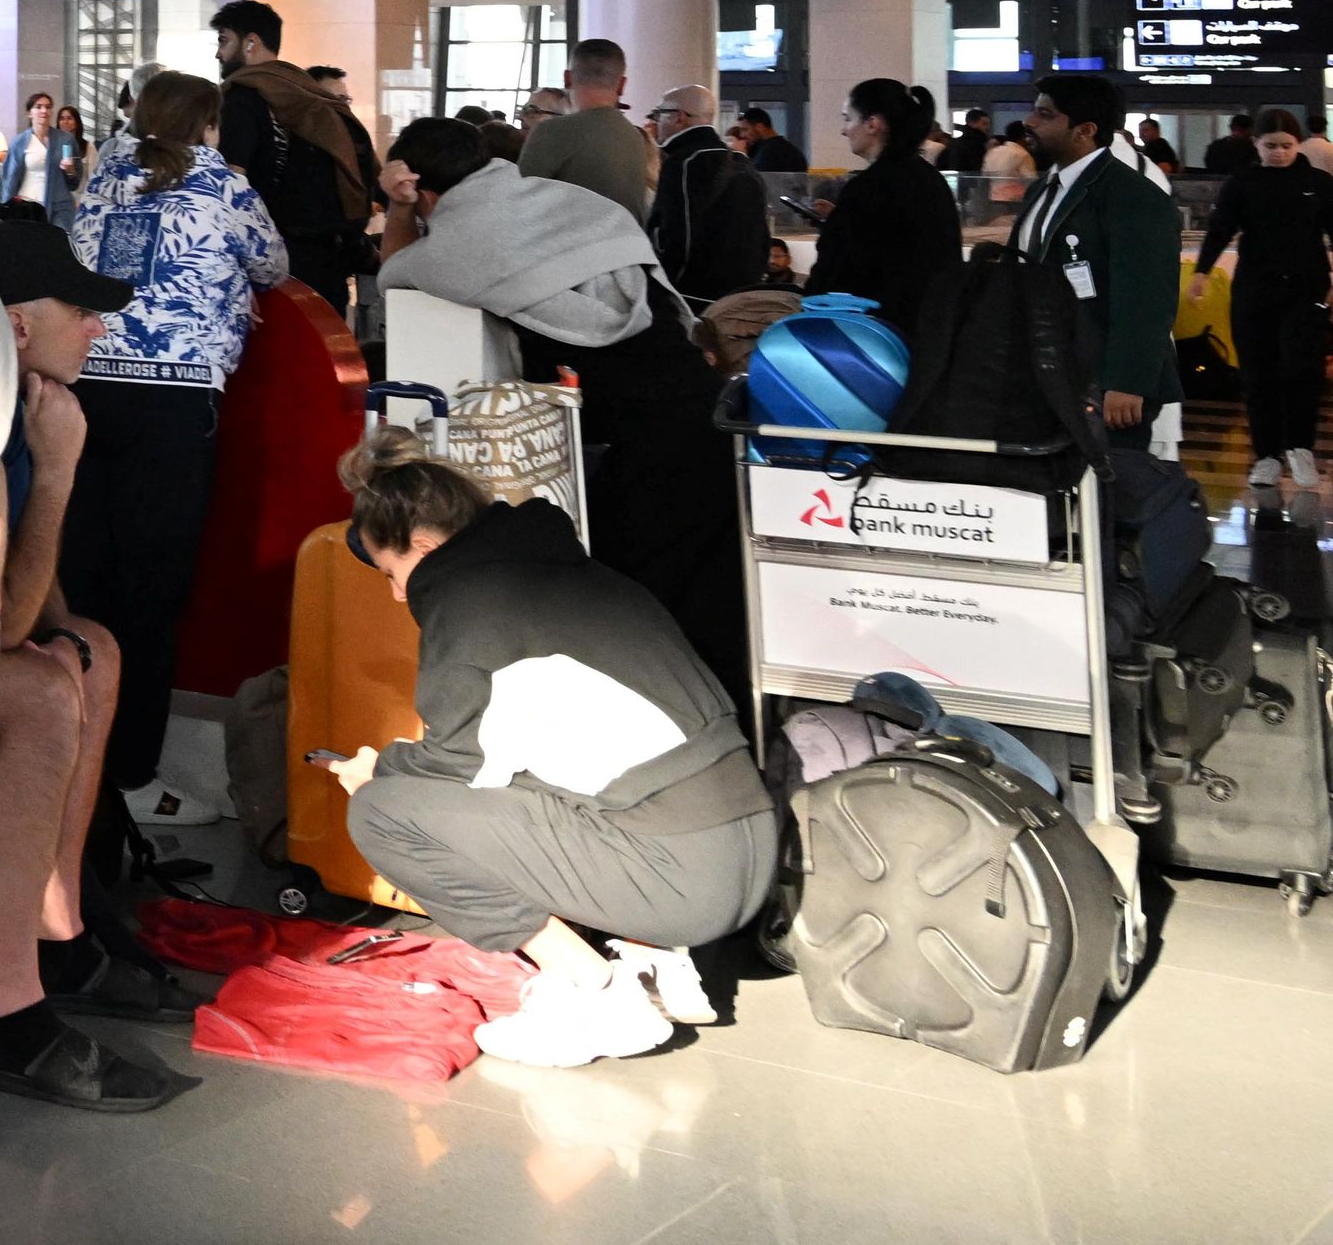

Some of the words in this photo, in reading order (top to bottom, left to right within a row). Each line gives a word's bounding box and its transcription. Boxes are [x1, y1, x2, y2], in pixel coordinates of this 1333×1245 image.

[80, 360, 157, 377] IADELLEROSE
[853, 490, 937, 513] مسقط
[942, 499, 994, 523] بنك
[851, 514, 906, 535] bank
[911, 524, 994, 543] muscat
[830, 597, 857, 608] Bank
[861, 600, 903, 613] Muscat.
[906, 606, 940, 618] Better
[943, 609, 999, 624] Everyday.
